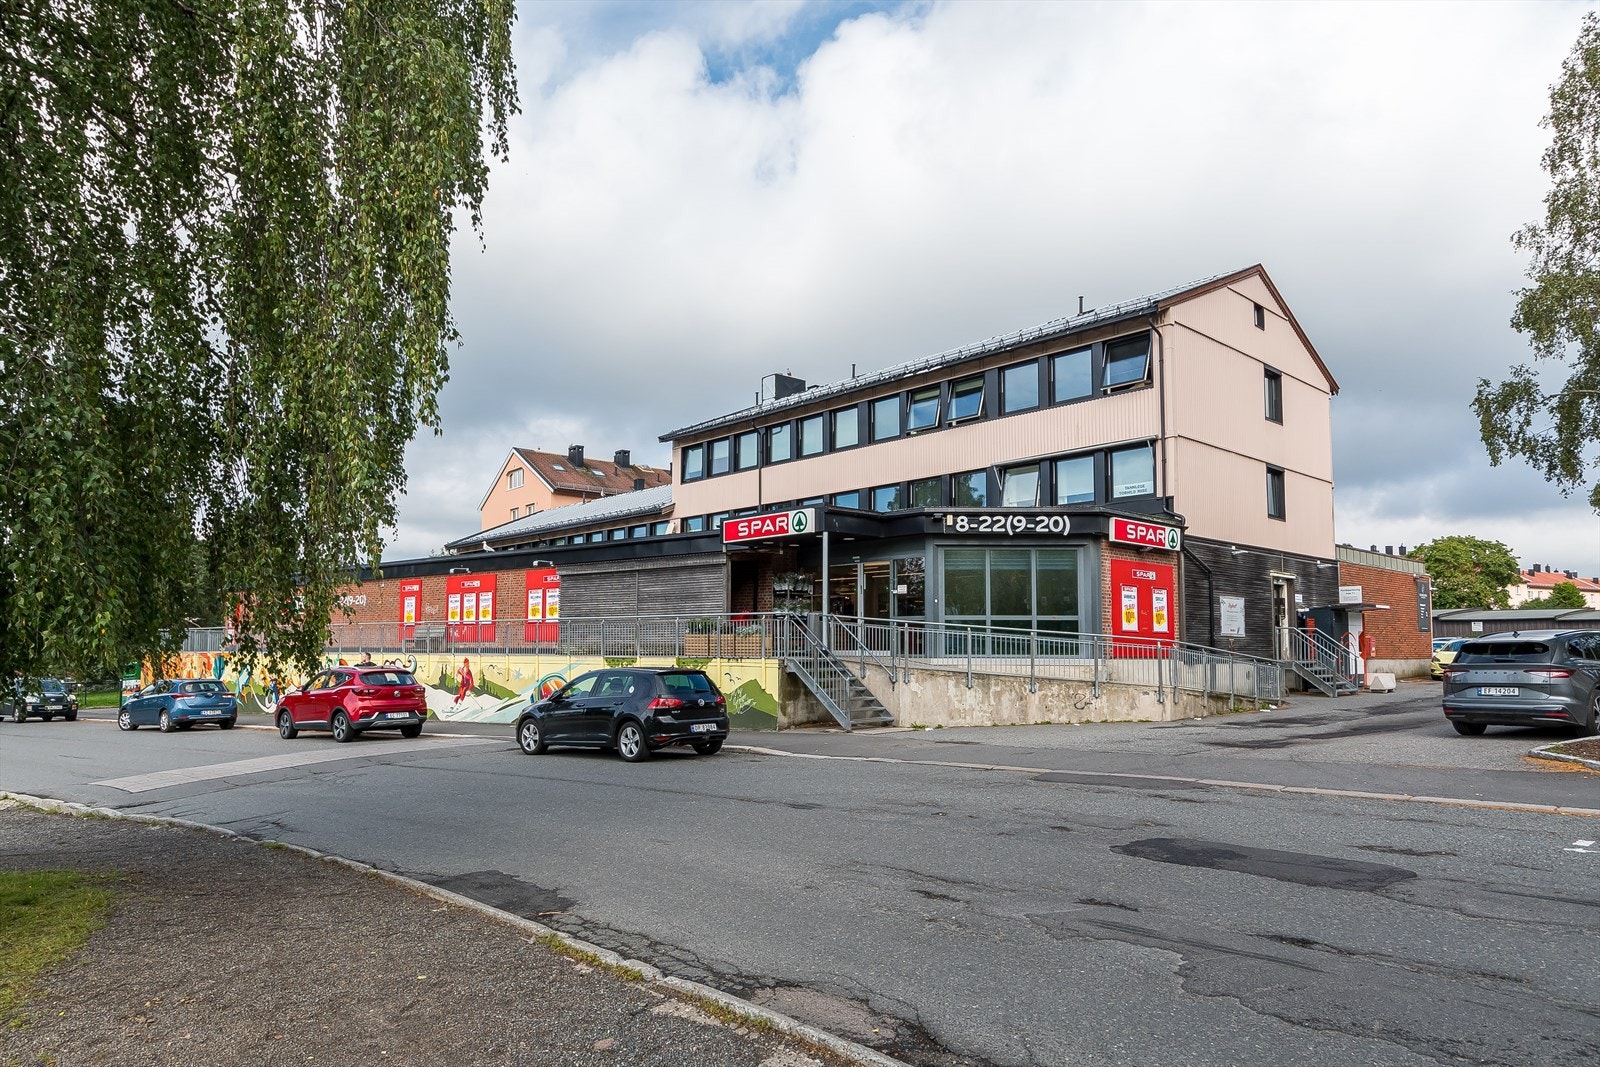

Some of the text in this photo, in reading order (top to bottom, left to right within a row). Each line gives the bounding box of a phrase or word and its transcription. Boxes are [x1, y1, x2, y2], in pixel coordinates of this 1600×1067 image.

[738, 516, 788, 537] SPAR
[955, 515, 1070, 536] 8-22(9-20)
[1126, 524, 1165, 544] SPAR
[1136, 571, 1151, 579] SPAR
